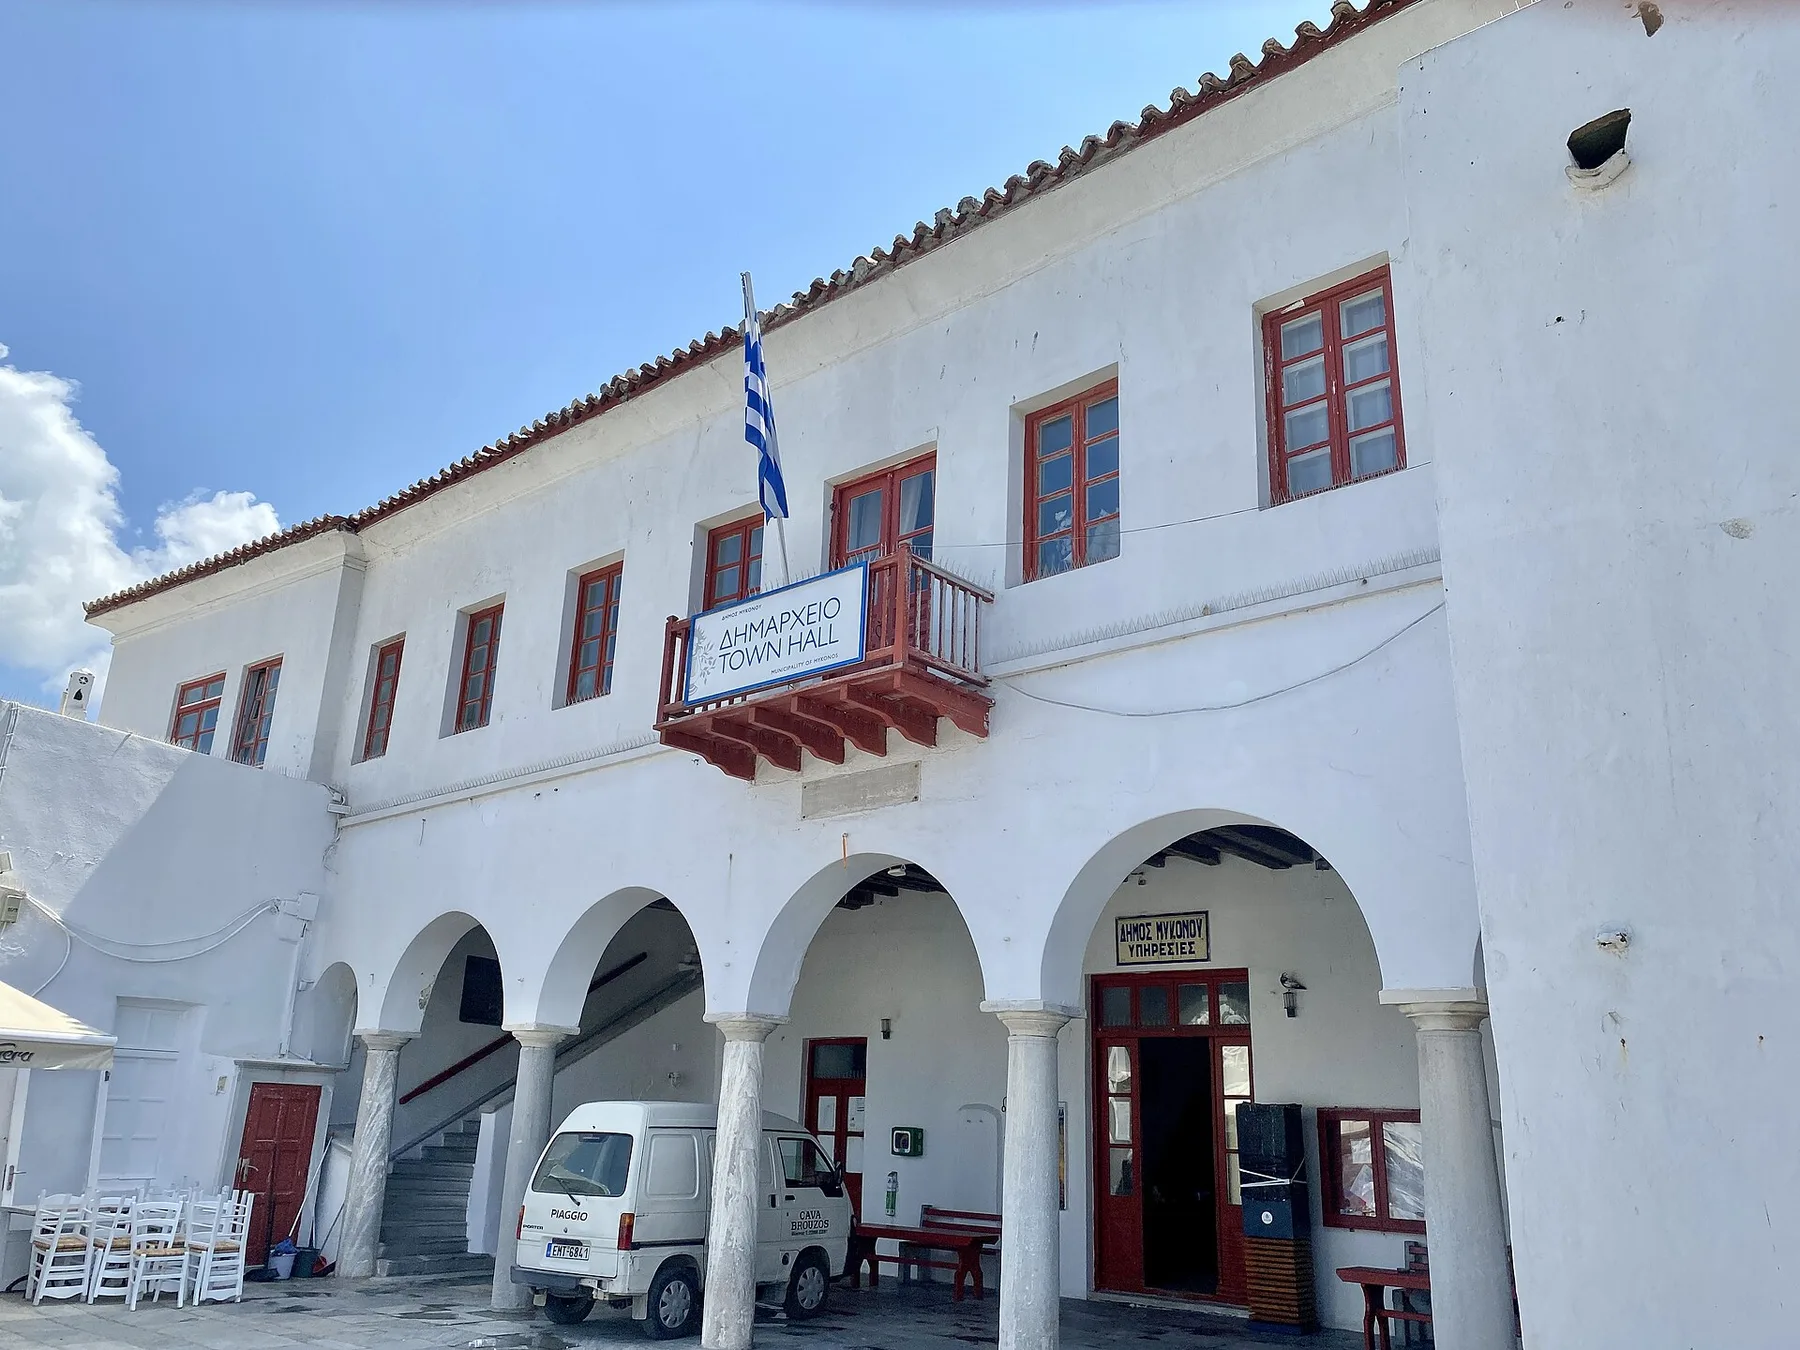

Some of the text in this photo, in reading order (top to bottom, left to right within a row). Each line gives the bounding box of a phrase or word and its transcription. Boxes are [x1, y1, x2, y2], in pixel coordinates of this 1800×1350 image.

[719, 597, 841, 651] ΔΗΜΑΡΧΕΙΟ
[718, 623, 839, 674] TOWN HALL
[770, 661, 804, 675] MUNICIPALITY
[813, 652, 839, 664] MYKONOS
[1120, 918, 1203, 943] ΔΗΜΟΣ ΜΥΚΟΝΟΥ
[1128, 941, 1196, 958] ΥΠΗΡΕΣΙΕΣ
[550, 1208, 588, 1222] PIAGGIO
[791, 1219, 829, 1231] BROUZOS
[799, 1210, 822, 1220] CAVA
